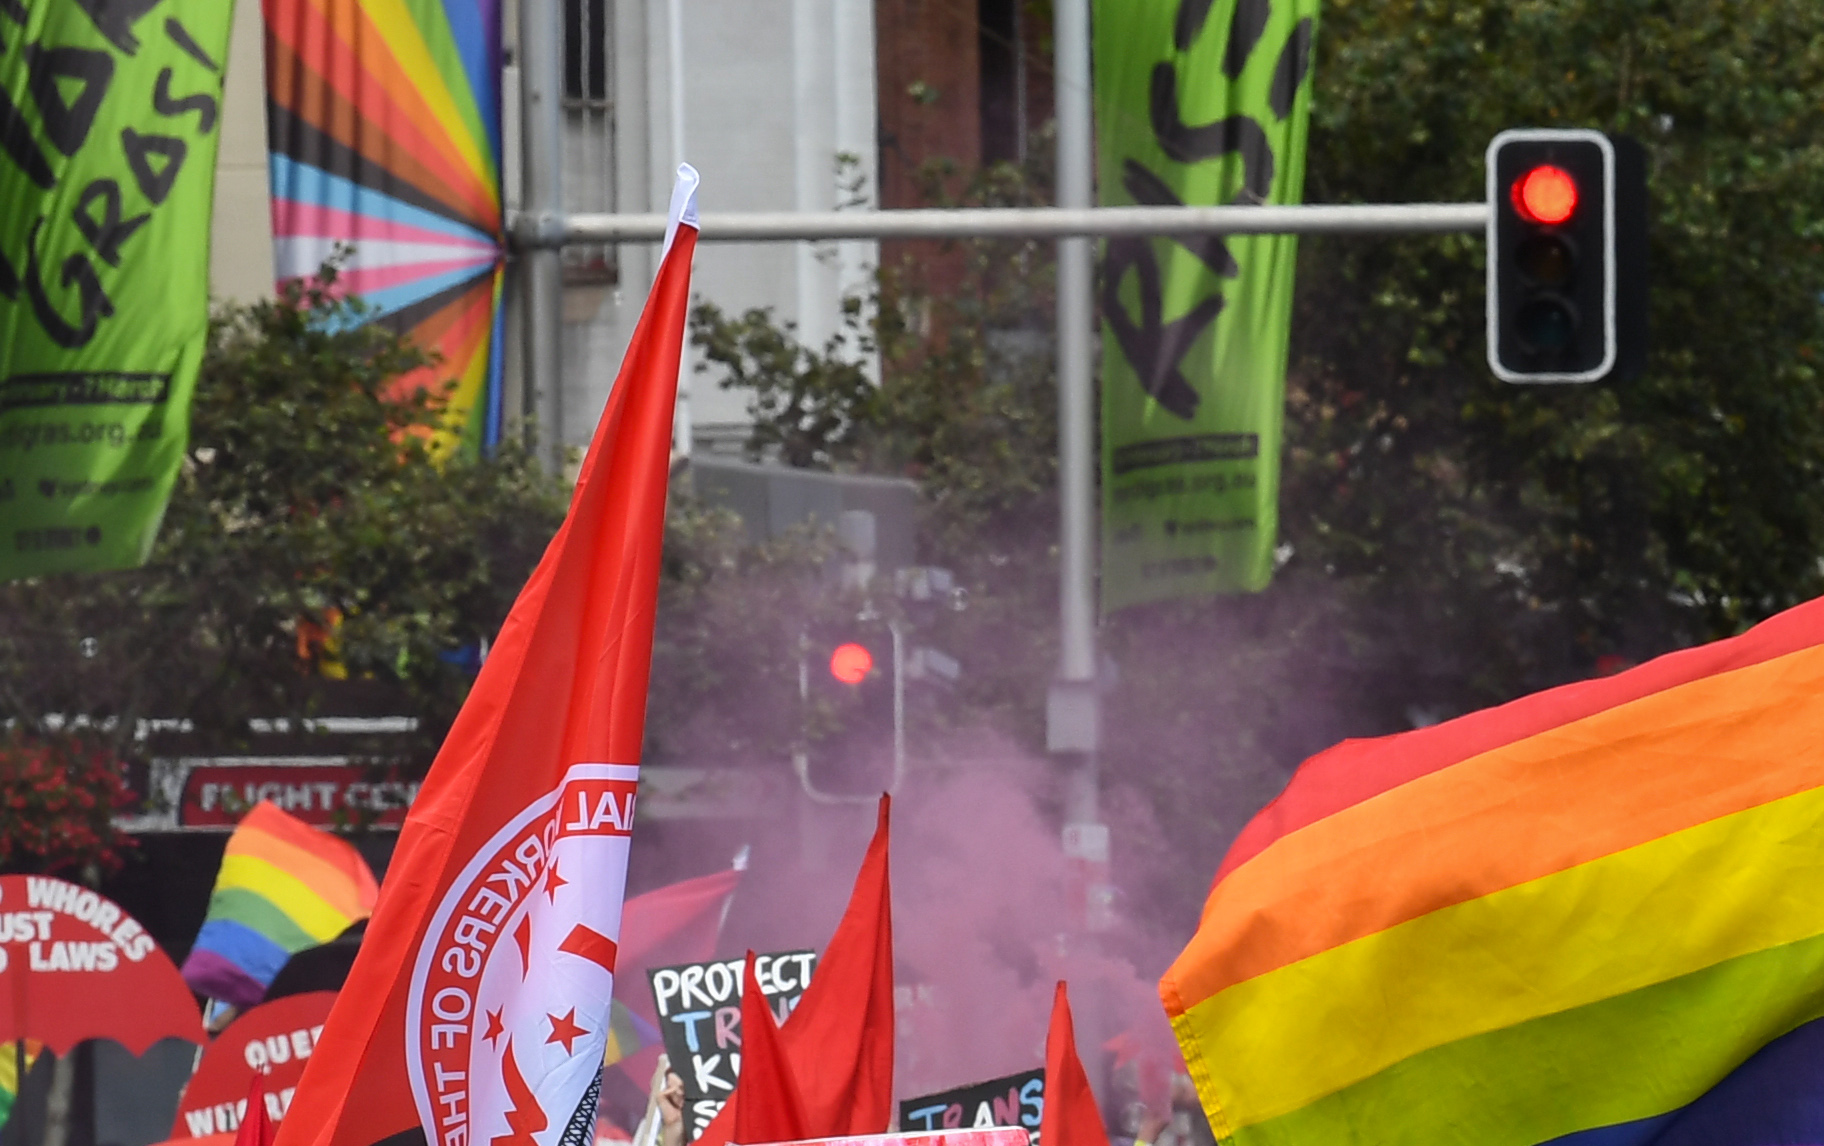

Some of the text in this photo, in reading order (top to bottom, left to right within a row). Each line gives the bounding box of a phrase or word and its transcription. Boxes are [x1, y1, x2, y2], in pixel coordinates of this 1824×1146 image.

[200, 780, 338, 812] FLIGHT
[26, 876, 156, 962] WHORES
[29, 940, 119, 972] LAWS
[653, 952, 817, 1017] PROTECT
[908, 1078, 1044, 1131] TRANS
